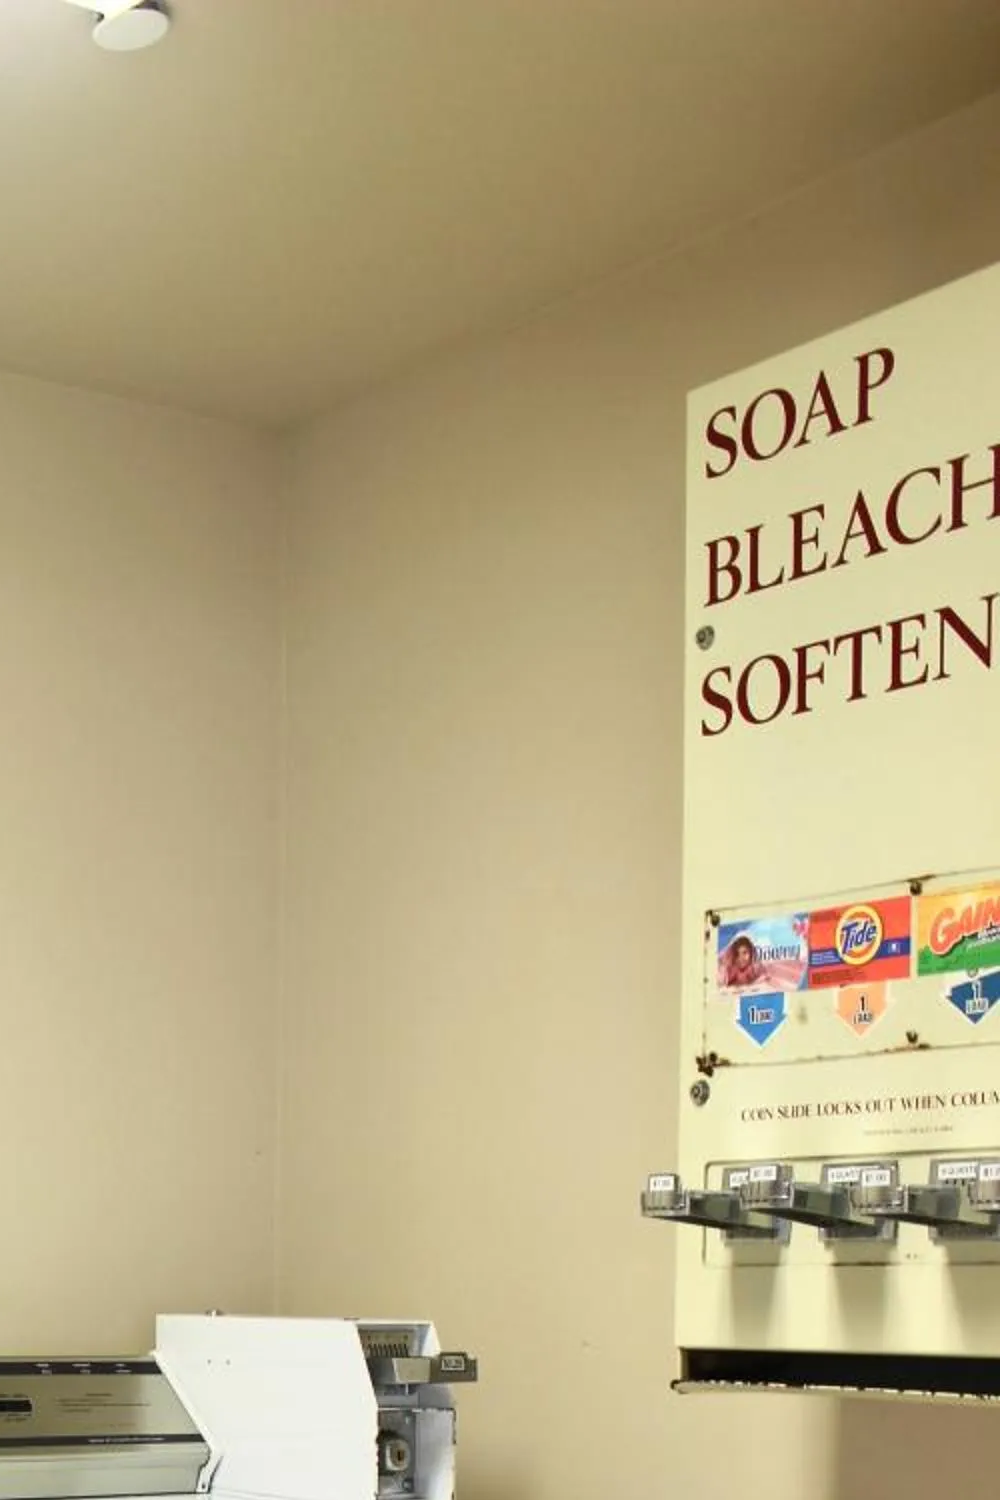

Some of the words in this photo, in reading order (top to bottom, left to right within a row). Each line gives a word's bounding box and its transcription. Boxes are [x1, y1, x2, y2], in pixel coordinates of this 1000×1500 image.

[705, 347, 895, 479] SOAP
[703, 443, 1000, 608] BLEACH
[701, 592, 1000, 737] SOFTEN
[841, 920, 876, 954] Tide
[741, 1105, 773, 1121] COIN
[777, 1102, 811, 1119] SLIDE
[817, 1100, 862, 1117] LOCKS
[865, 1098, 897, 1113] OUT
[901, 1095, 946, 1113] WHEN
